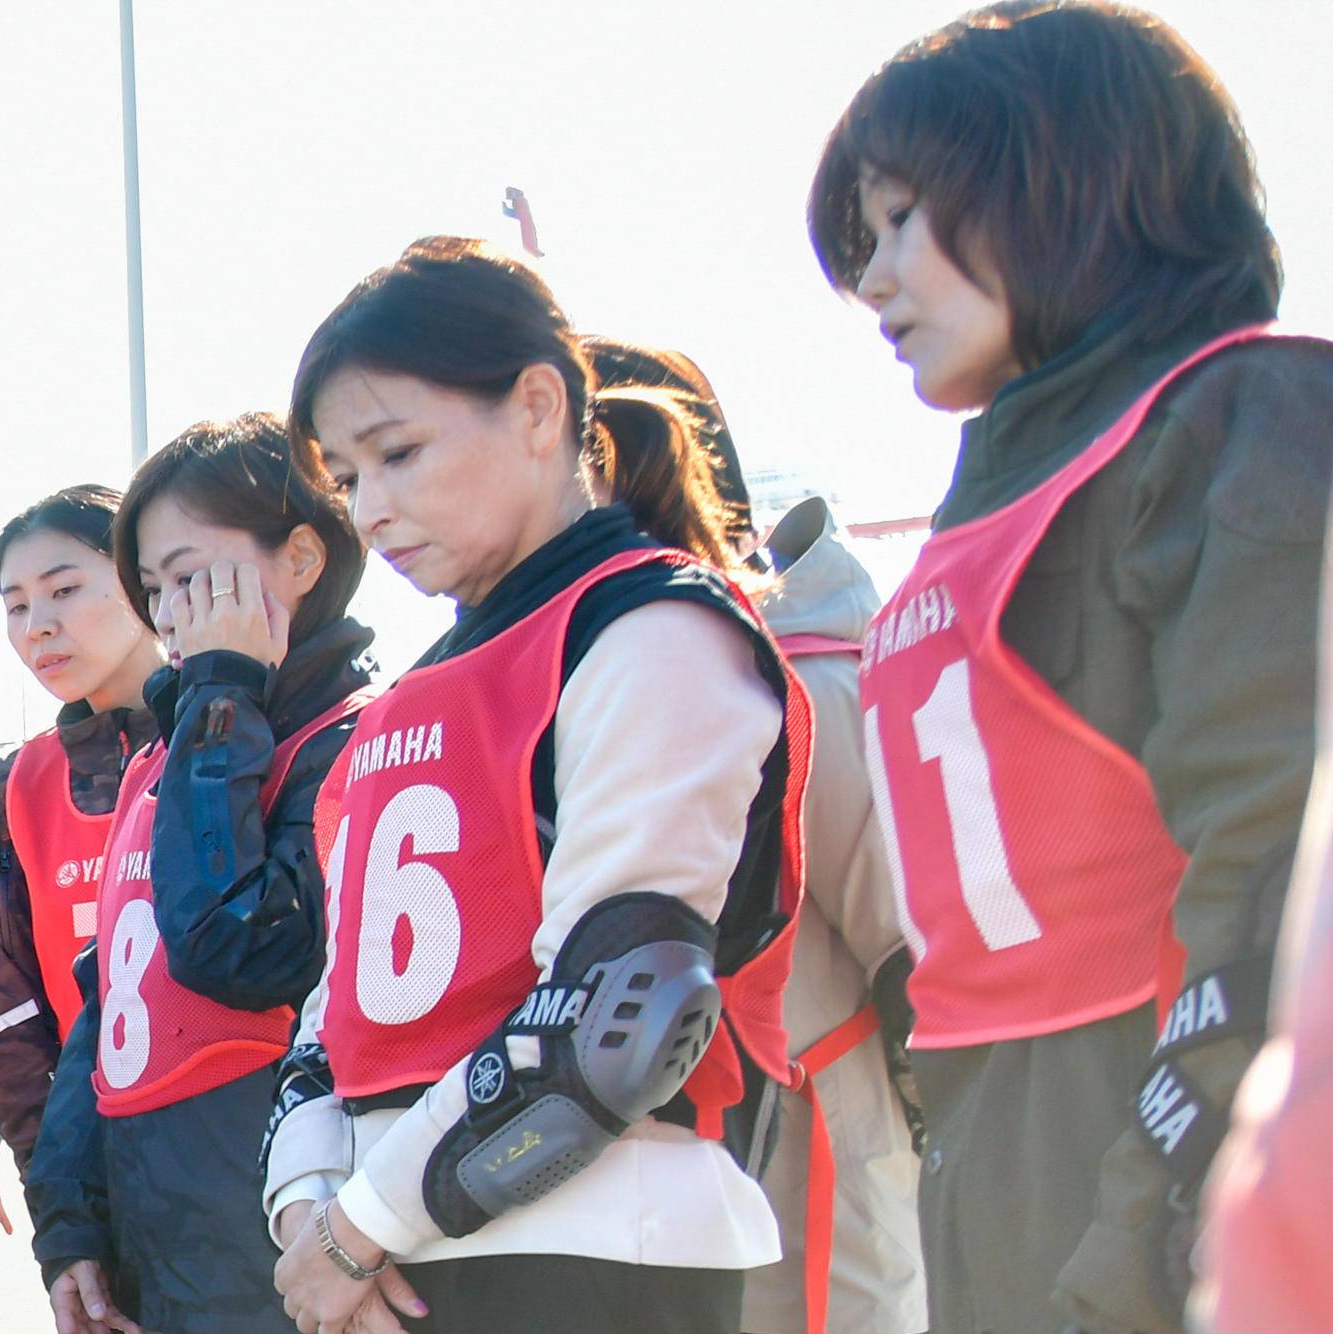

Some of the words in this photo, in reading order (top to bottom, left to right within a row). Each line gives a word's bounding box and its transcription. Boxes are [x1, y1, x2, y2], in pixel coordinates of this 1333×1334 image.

[353, 722, 444, 783] YAMAHA
[100, 898, 161, 1089] 8
[315, 784, 461, 1031] 16
